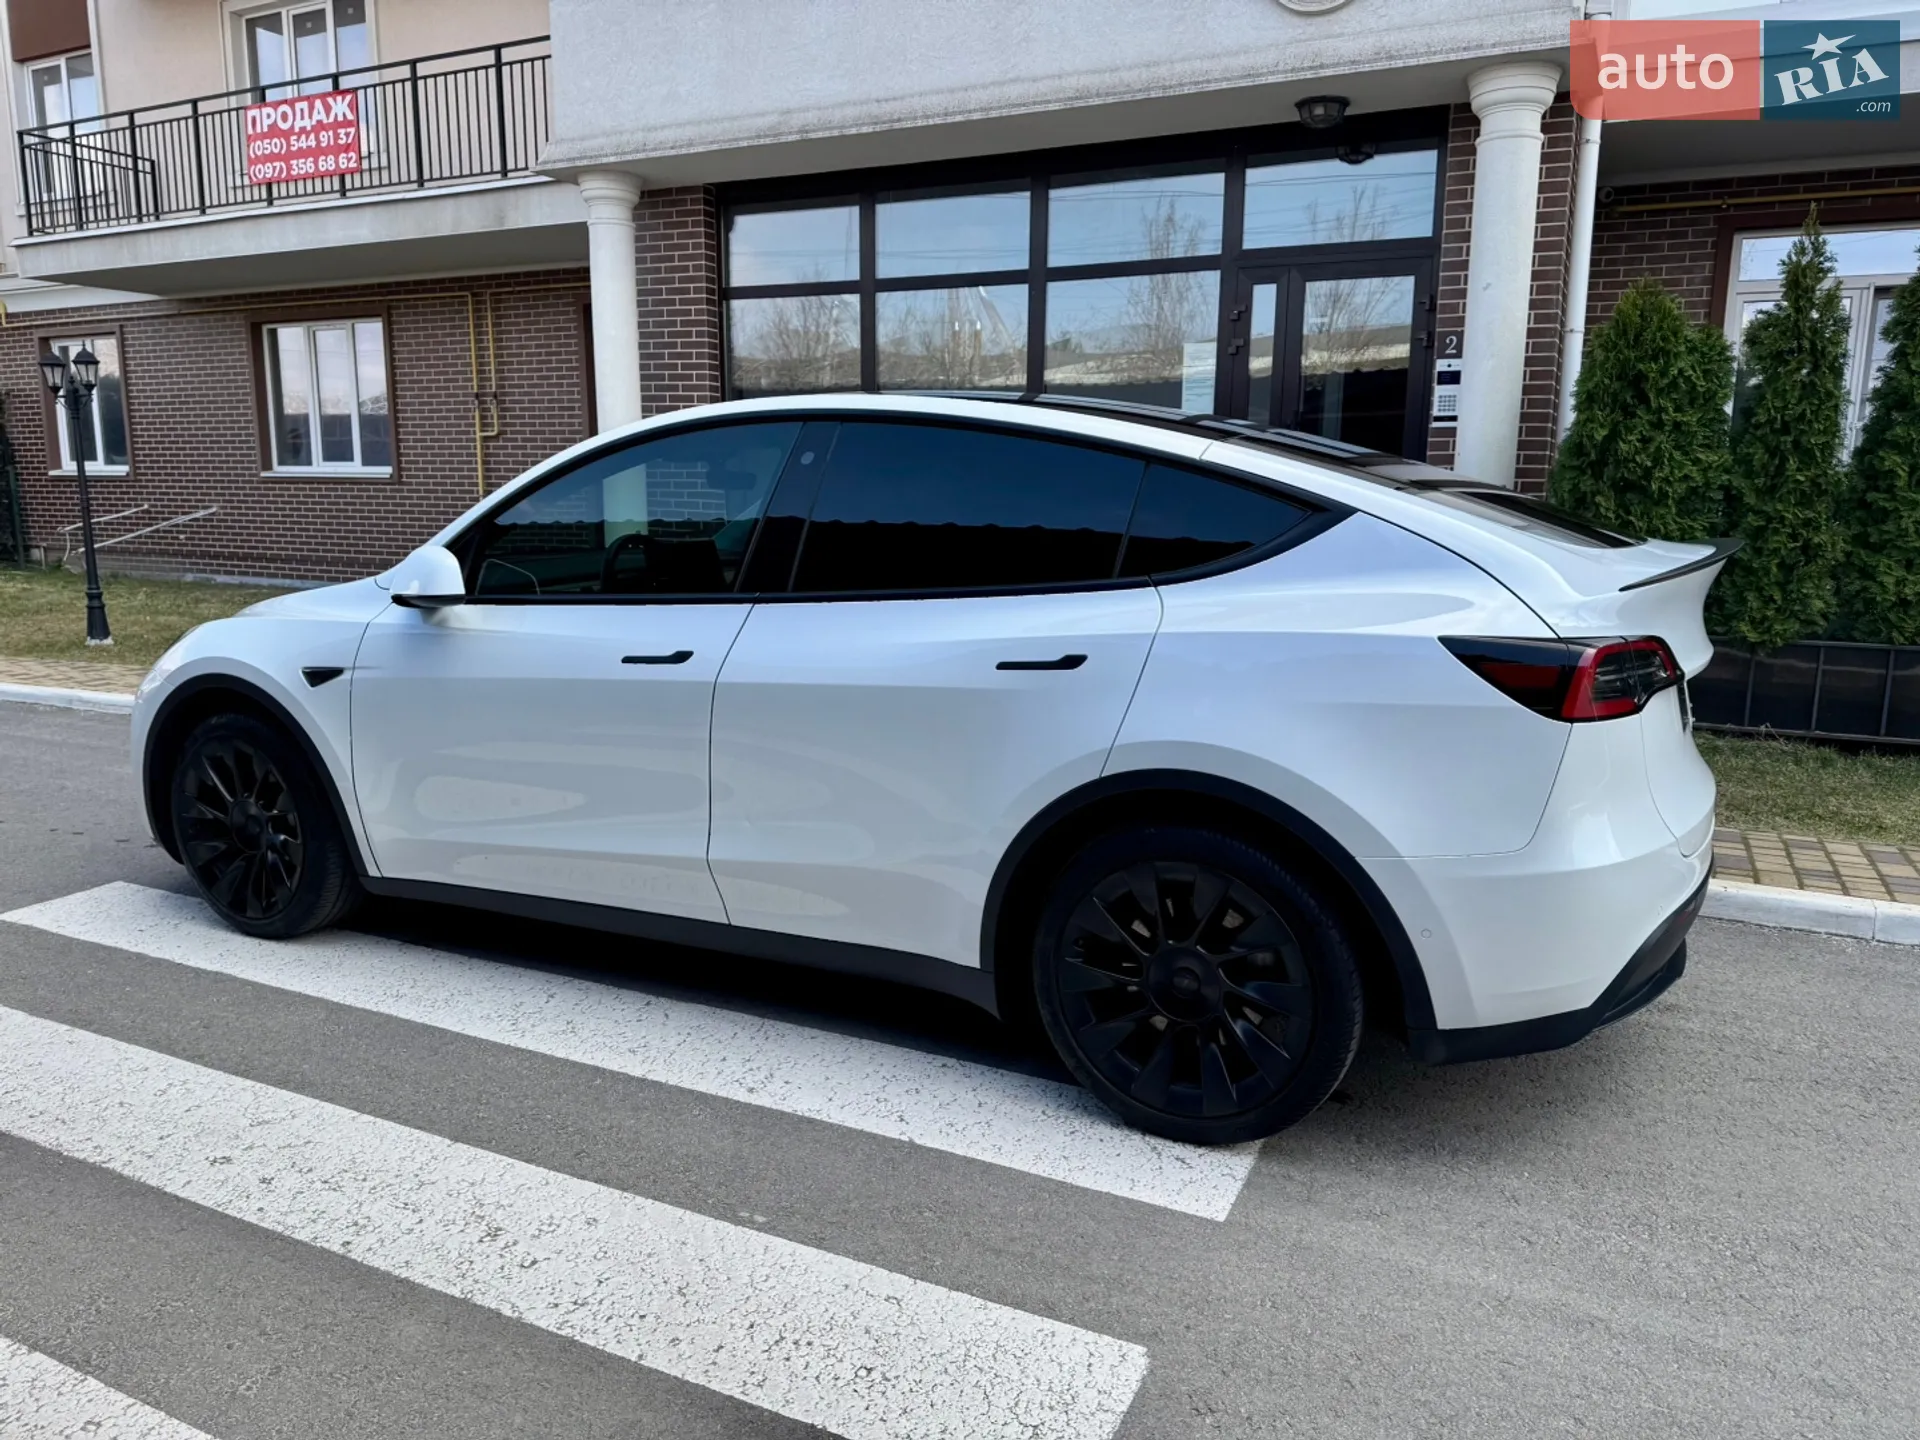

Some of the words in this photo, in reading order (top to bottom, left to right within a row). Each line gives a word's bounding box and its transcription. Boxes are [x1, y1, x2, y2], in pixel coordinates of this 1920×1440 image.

[246, 94, 355, 135] ПРОДАЖ
[249, 137, 287, 158] (050)
[290, 133, 317, 151] 544
[319, 130, 334, 147] 91
[337, 127, 356, 144] 37
[250, 161, 287, 181] (097)
[290, 157, 315, 176] 356
[318, 155, 335, 172] 68
[338, 152, 357, 169] 62
[1445, 335, 1457, 354] 2
